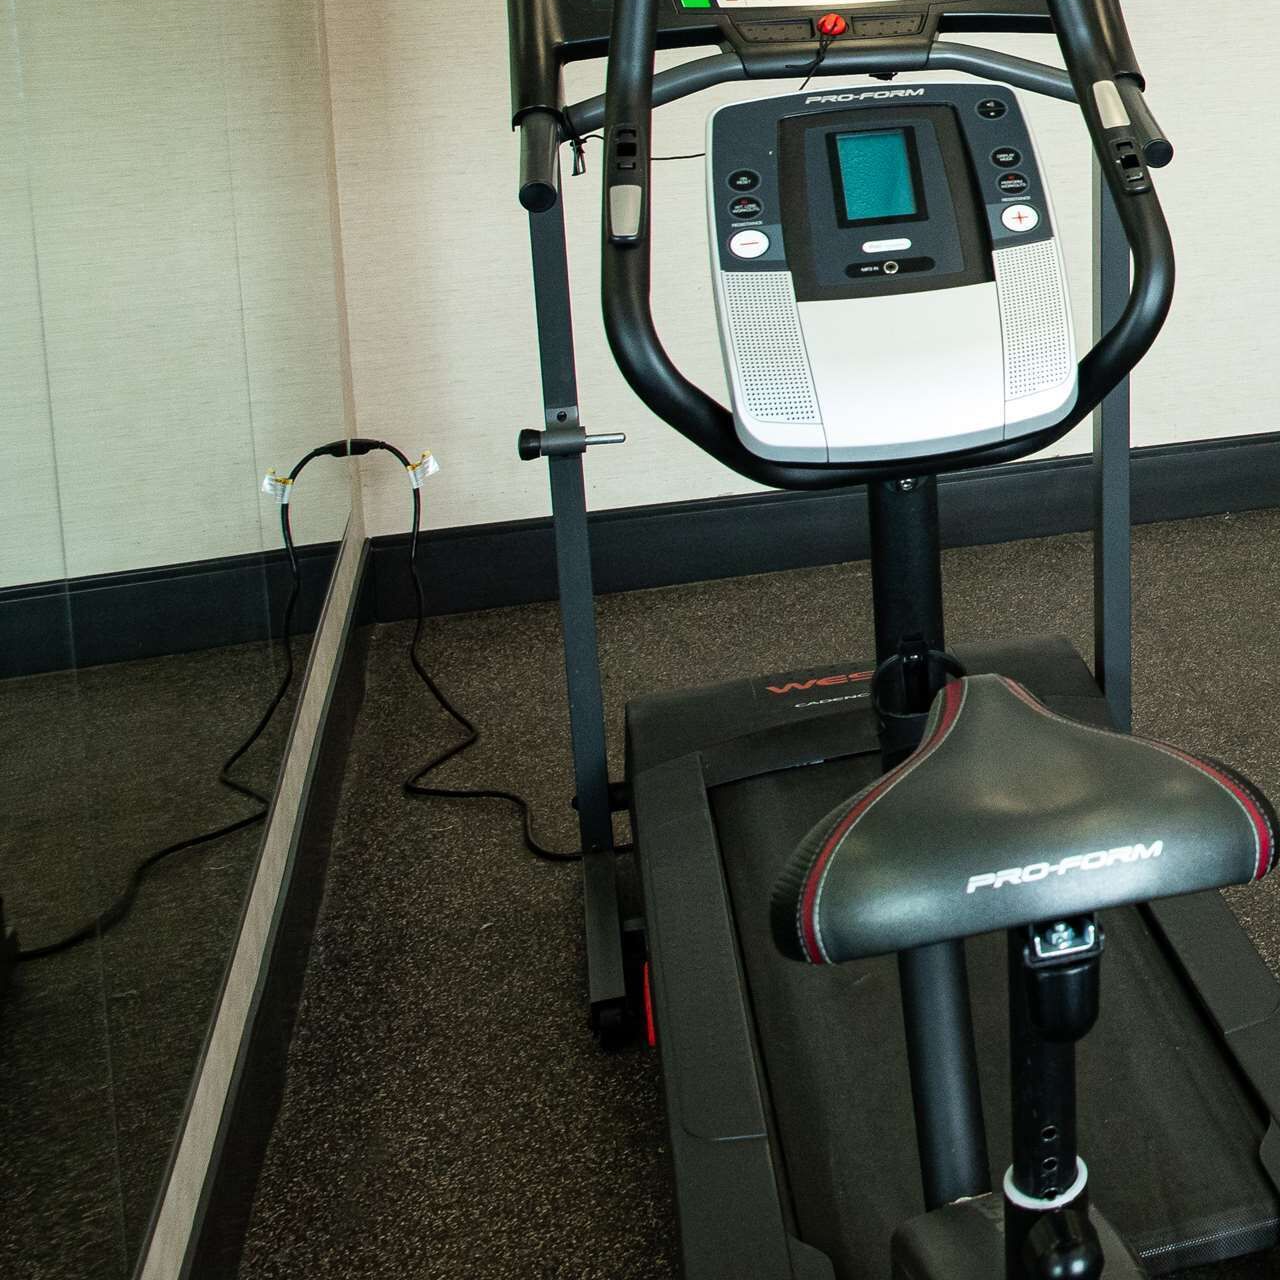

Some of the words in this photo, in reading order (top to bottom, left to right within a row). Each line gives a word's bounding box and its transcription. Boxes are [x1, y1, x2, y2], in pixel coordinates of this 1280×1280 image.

[805, 88, 925, 104] PRO-FORM
[765, 670, 875, 694] WES
[795, 692, 871, 708] CADENC
[966, 840, 1164, 894] PRO-FORM
